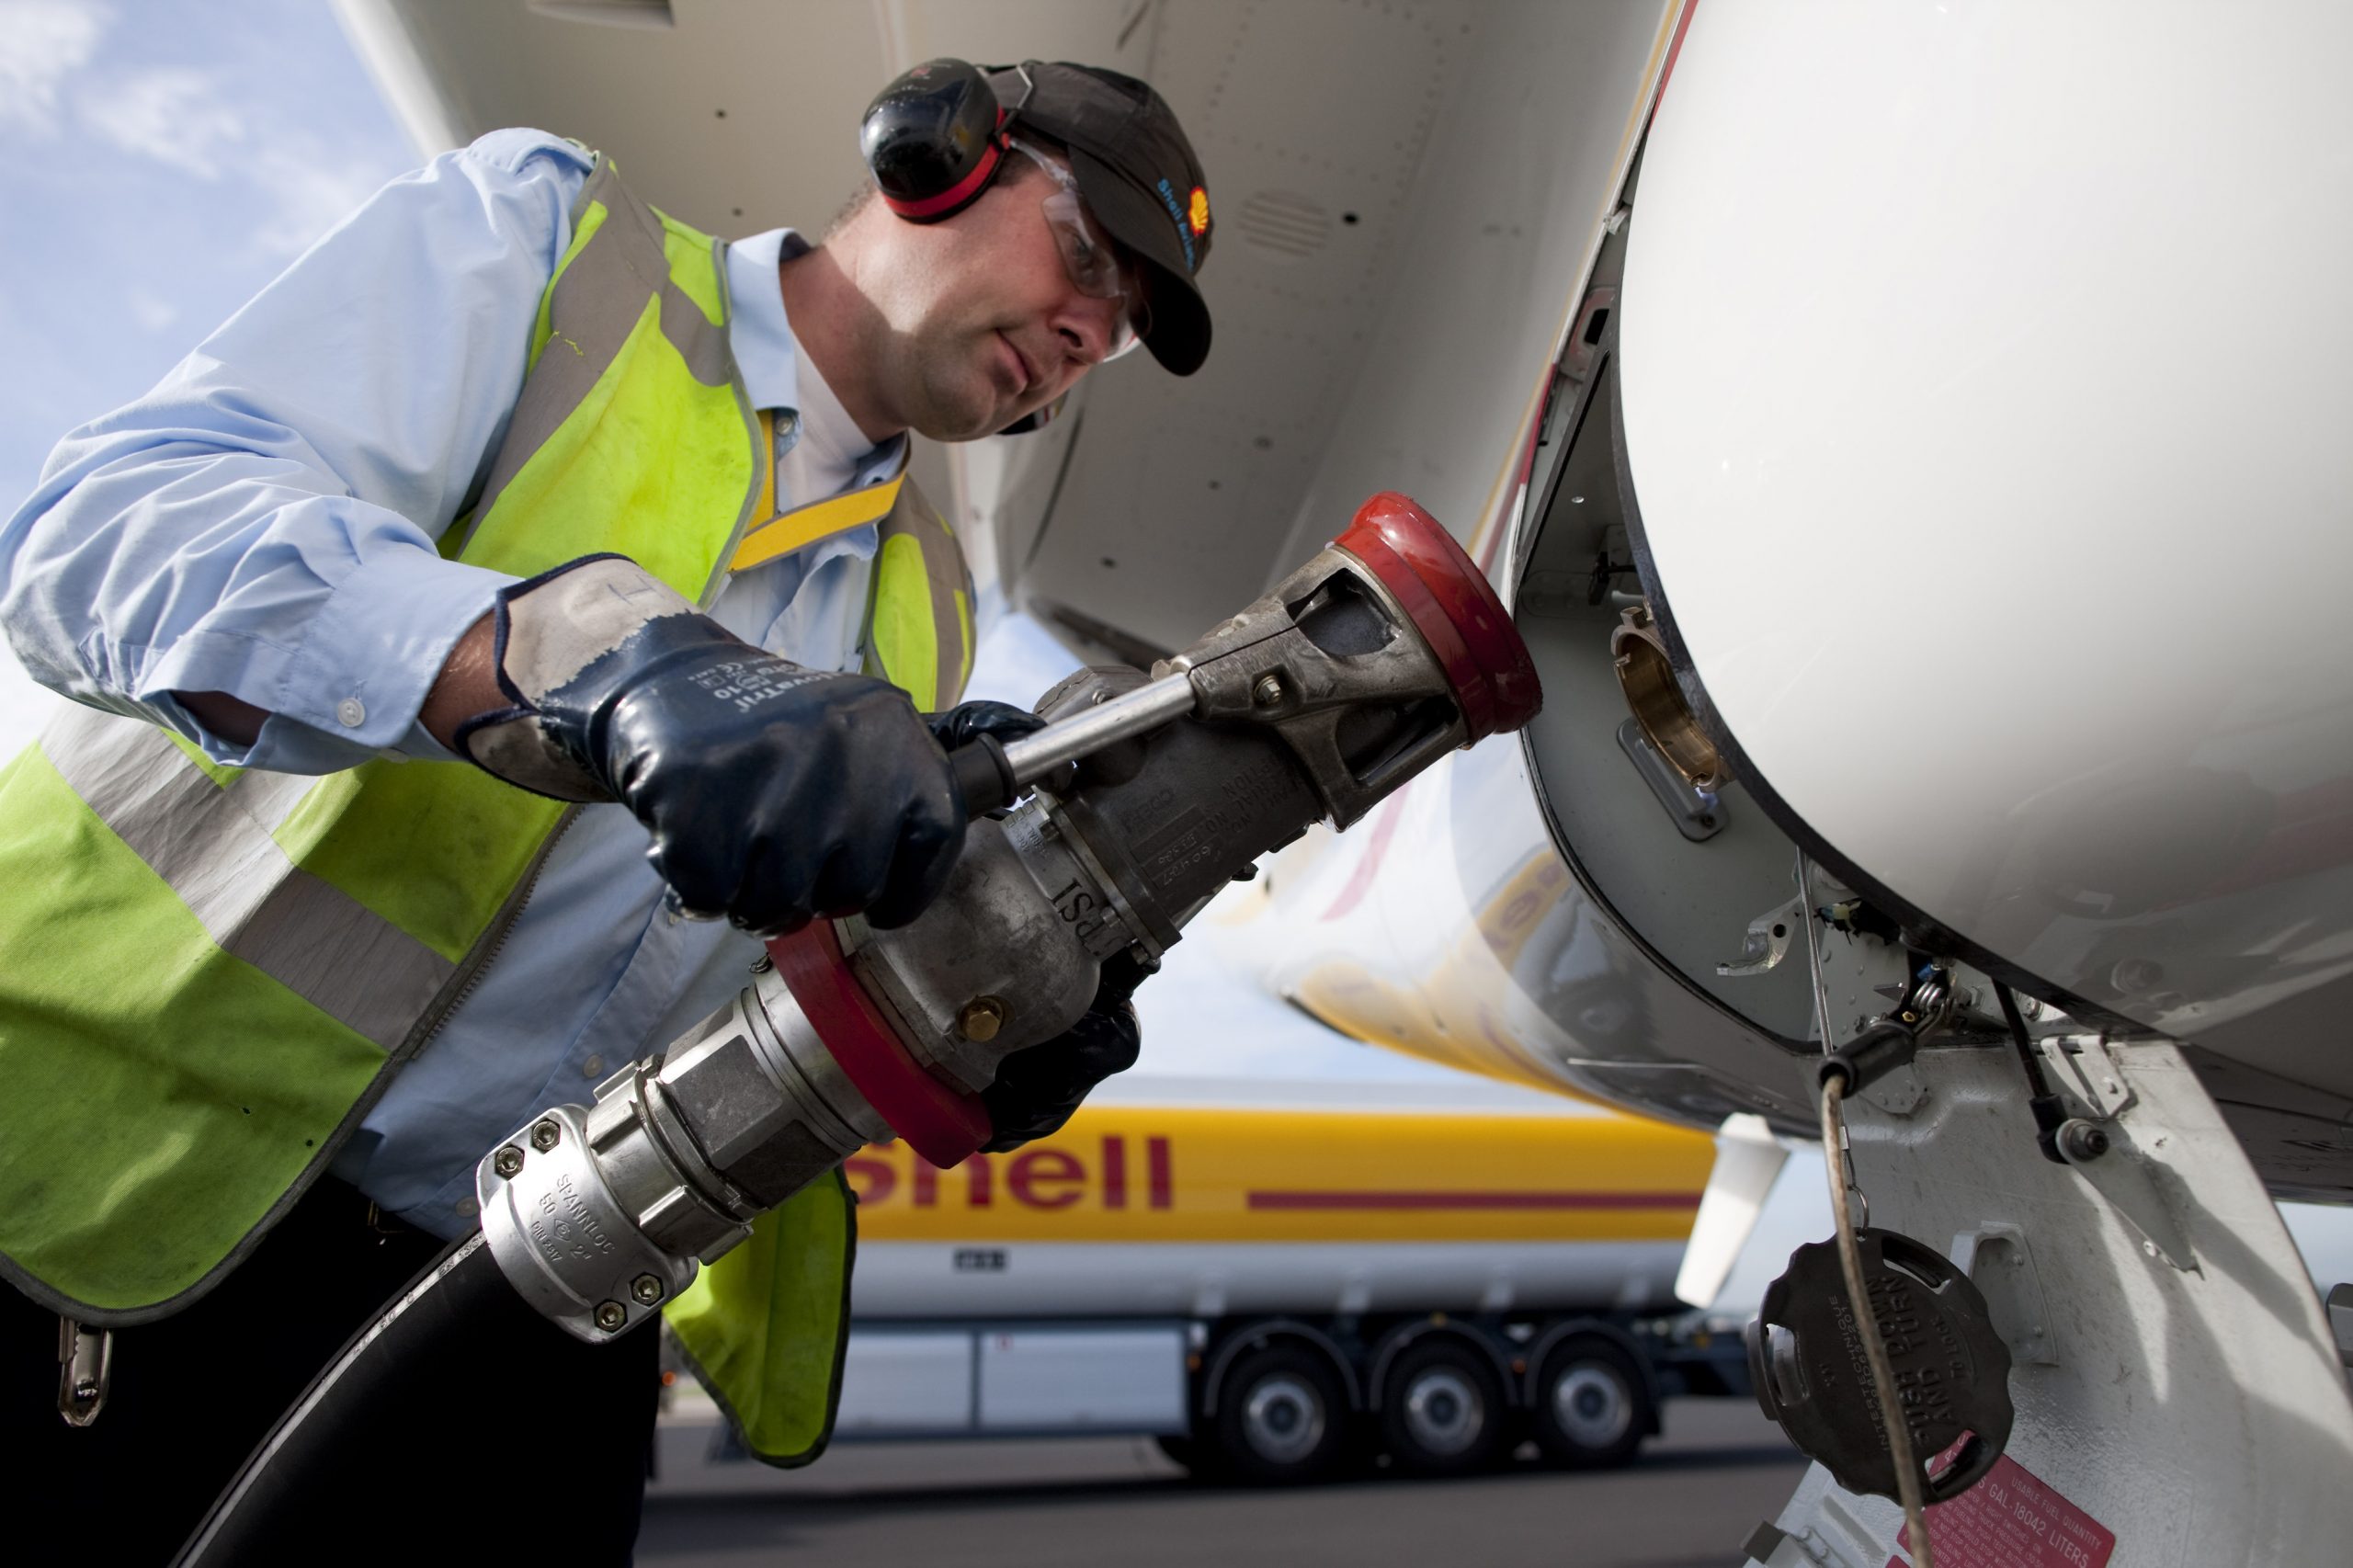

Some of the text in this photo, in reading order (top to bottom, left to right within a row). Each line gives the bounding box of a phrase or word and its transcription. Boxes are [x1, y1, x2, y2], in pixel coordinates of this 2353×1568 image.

[1156, 177, 1184, 221] Shell
[713, 685, 743, 699] 10
[1051, 877, 1104, 942] PSI
[843, 1136, 1176, 1211] Shell
[540, 1192, 558, 1216] 50
[557, 1174, 615, 1255] SPANNLOC
[531, 1221, 547, 1241] DIN
[1865, 1276, 1908, 1359] DOWN
[1881, 1275, 1927, 1350] TURN
[1929, 1315, 1959, 1356] LOCK
[1916, 1367, 1953, 1426] AND
[1952, 1506, 1975, 1528] FUELING
[1976, 1525, 1993, 1542] PUSH
[1991, 1538, 2006, 1553] TEST
[1978, 1511, 1995, 1530] TRUCK
[1995, 1526, 2024, 1555] PRESSURE
[1985, 1505, 2002, 1521] RIGHT
[2002, 1517, 2029, 1544] SWITCHES
[2011, 1477, 2102, 1550] USABLE FUEL QUANTITY
[1930, 1543, 1951, 1565] CENTER
[1938, 1521, 1950, 1535] NOT
[1949, 1530, 1964, 1547] STOP
[1962, 1542, 1986, 1567] FUELING
[1958, 1524, 1981, 1547] SHOULD
[1978, 1541, 1995, 1558] STOP
[2049, 1530, 2089, 1568] LITERS
